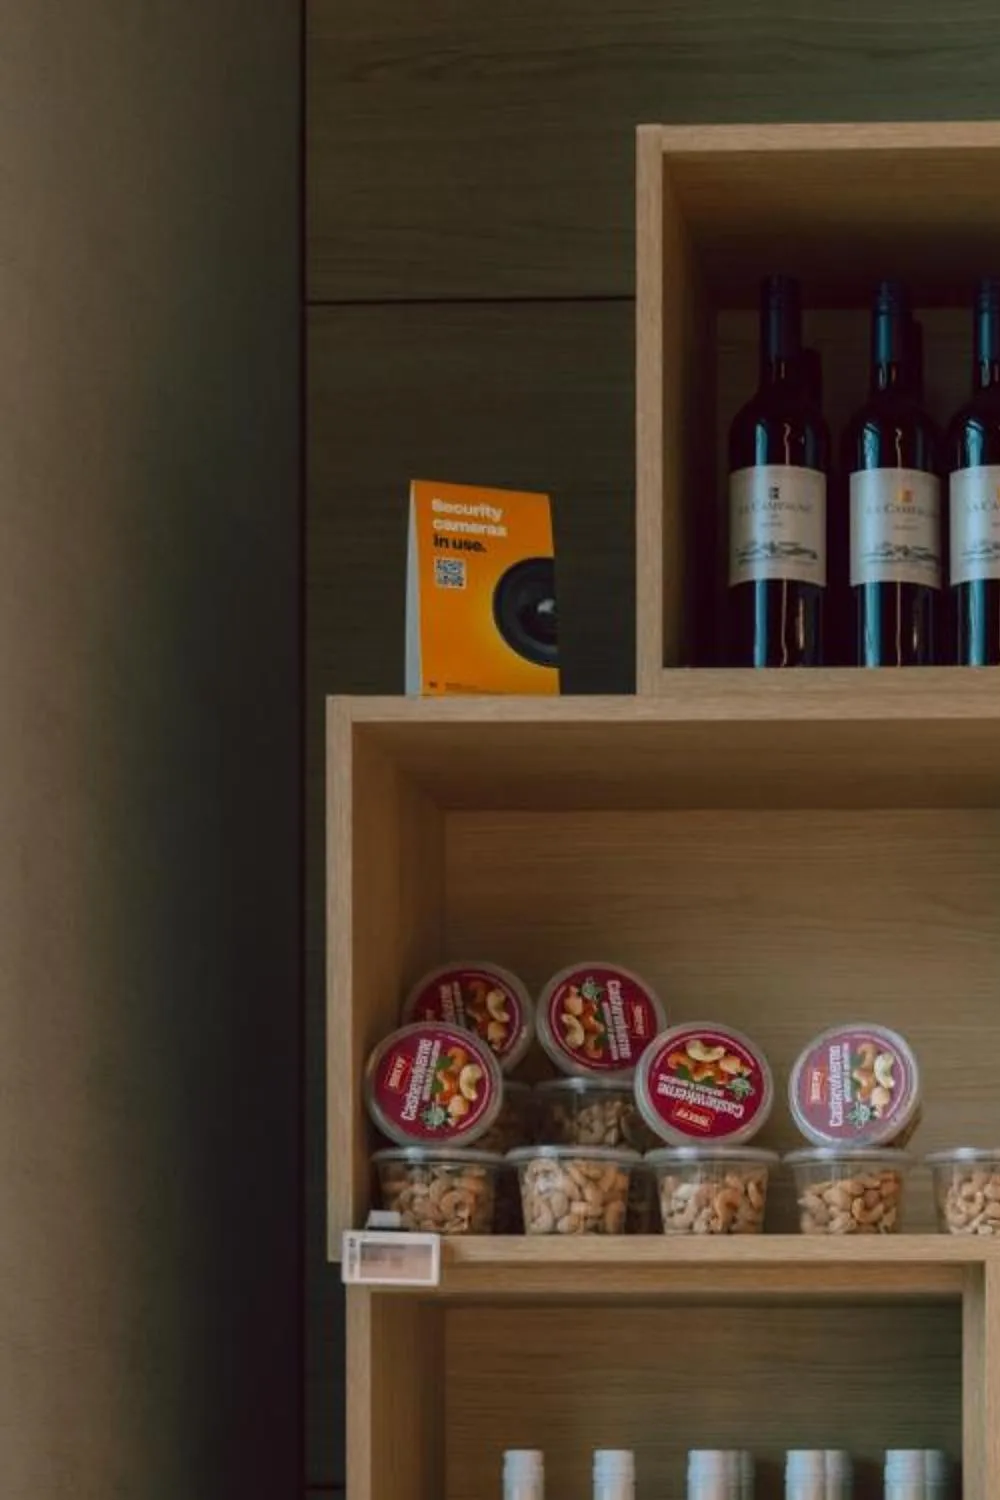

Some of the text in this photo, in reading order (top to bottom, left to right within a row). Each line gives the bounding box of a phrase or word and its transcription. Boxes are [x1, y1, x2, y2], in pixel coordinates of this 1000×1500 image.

[432, 498, 504, 522] Security
[432, 518, 507, 537] cameras
[434, 533, 488, 552] in use.
